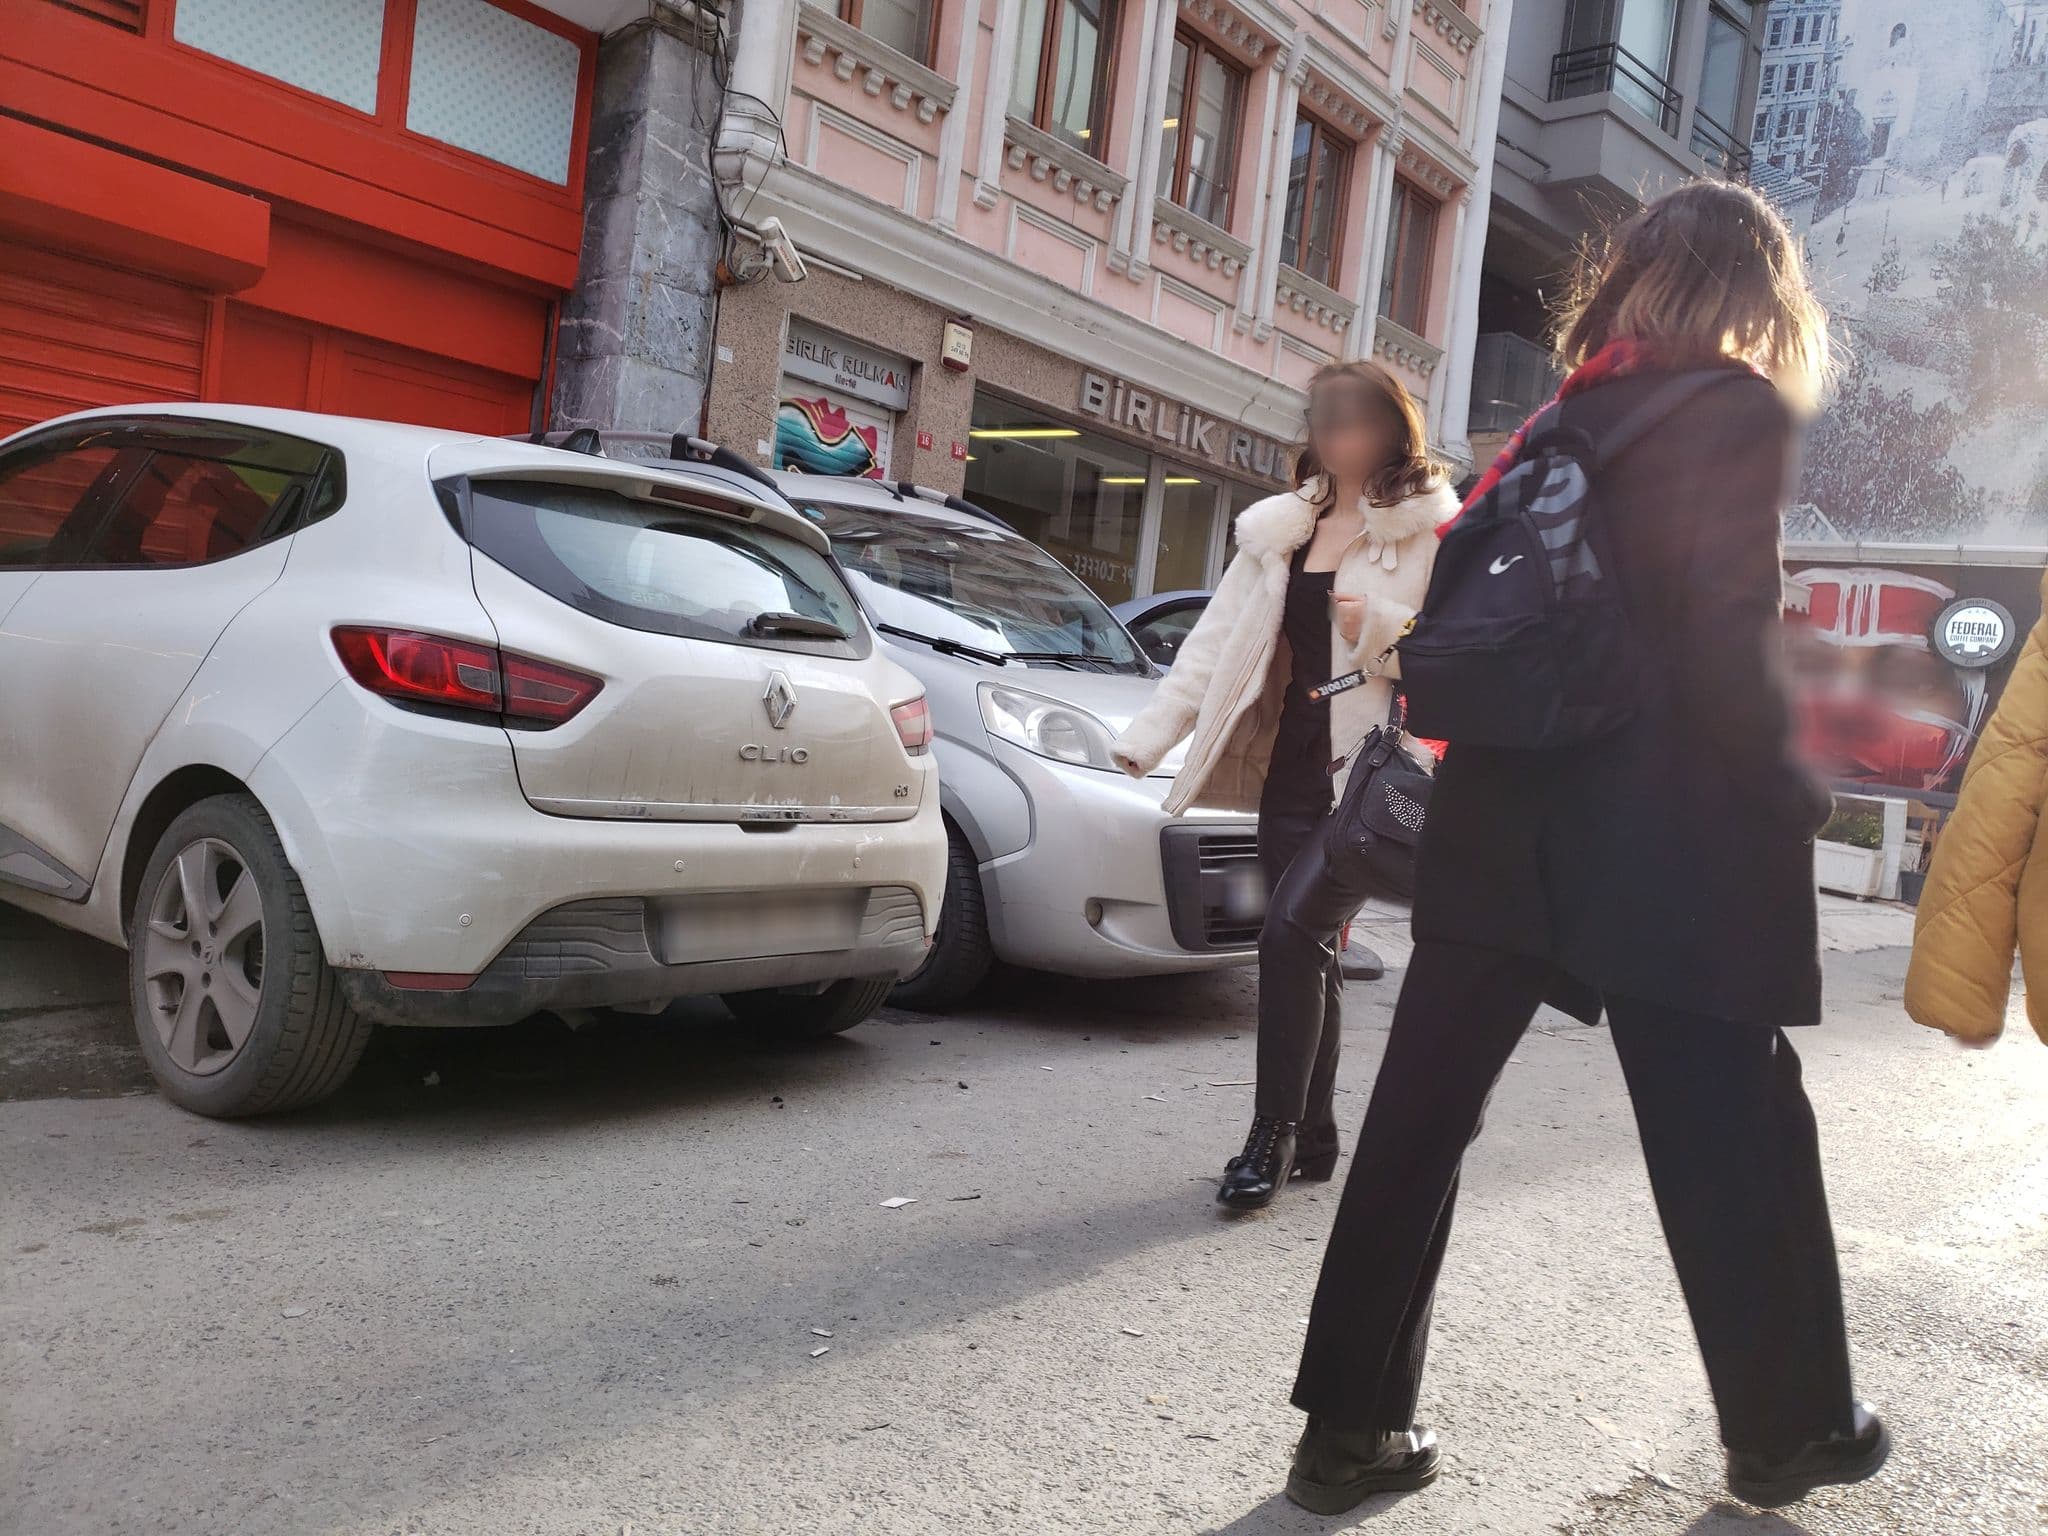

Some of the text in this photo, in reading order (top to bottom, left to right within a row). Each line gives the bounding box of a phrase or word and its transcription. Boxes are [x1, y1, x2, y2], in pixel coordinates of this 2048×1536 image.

[842, 355, 907, 393] RULMAN
[1079, 372, 1290, 482] BİRLİK RUL
[1951, 621, 1998, 637] FEDERAL
[1969, 635, 1998, 644] COMPANY
[738, 743, 809, 765] CLIO
